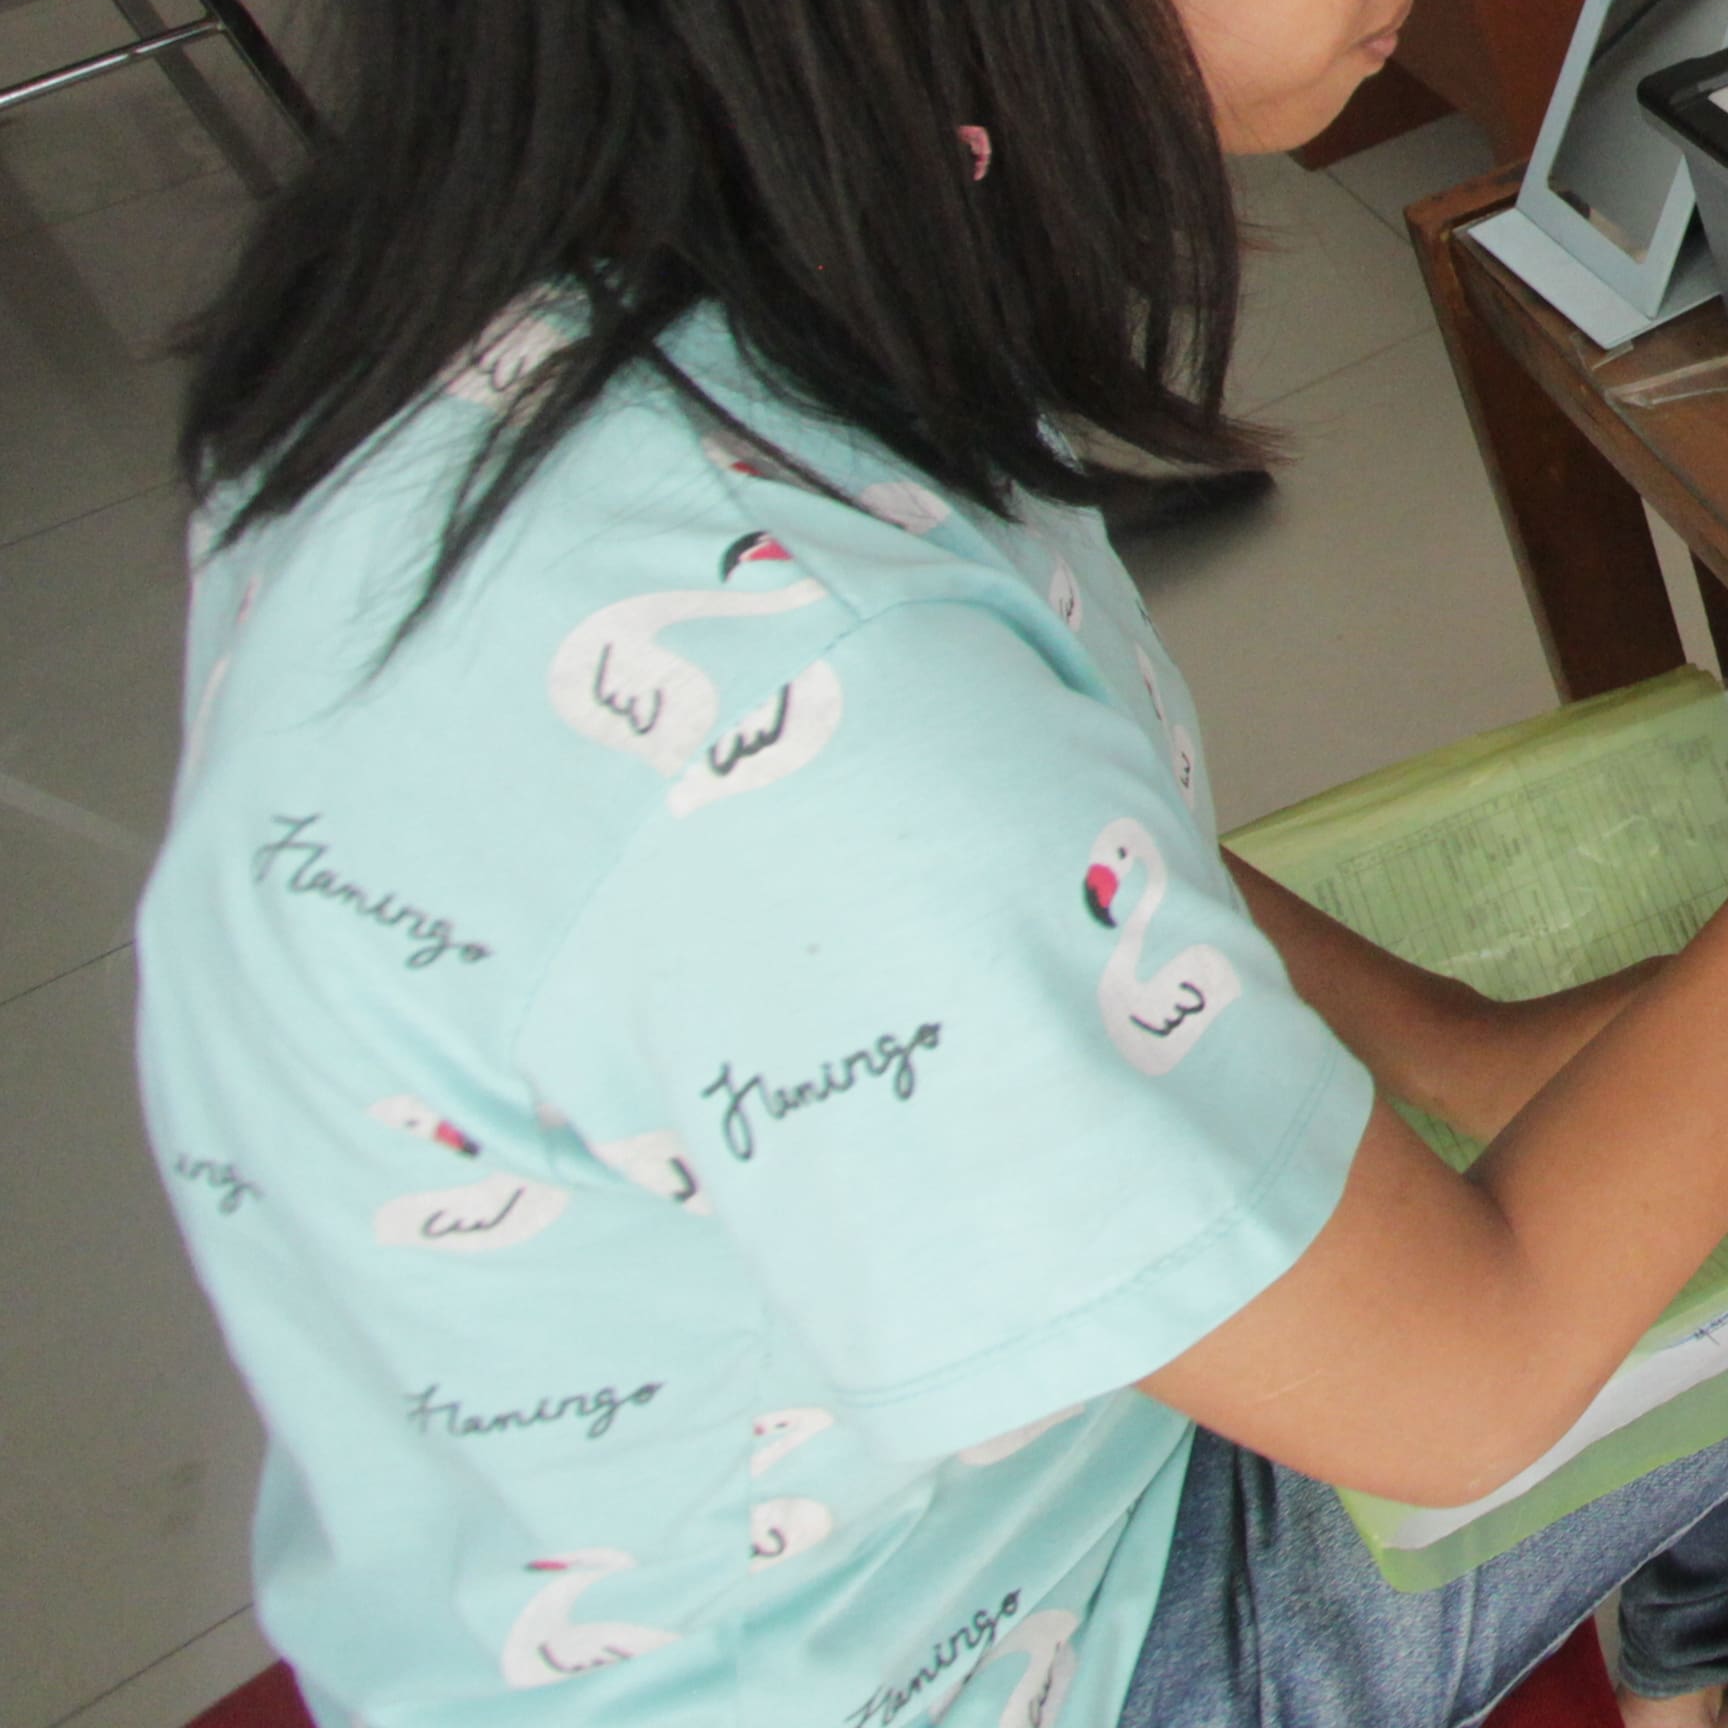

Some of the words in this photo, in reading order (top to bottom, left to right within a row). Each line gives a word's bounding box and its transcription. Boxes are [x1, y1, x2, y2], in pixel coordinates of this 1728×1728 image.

[251, 813, 494, 970] Flamingo
[701, 1020, 943, 1162] Flamingo
[401, 1381, 666, 1440] Flamingo
